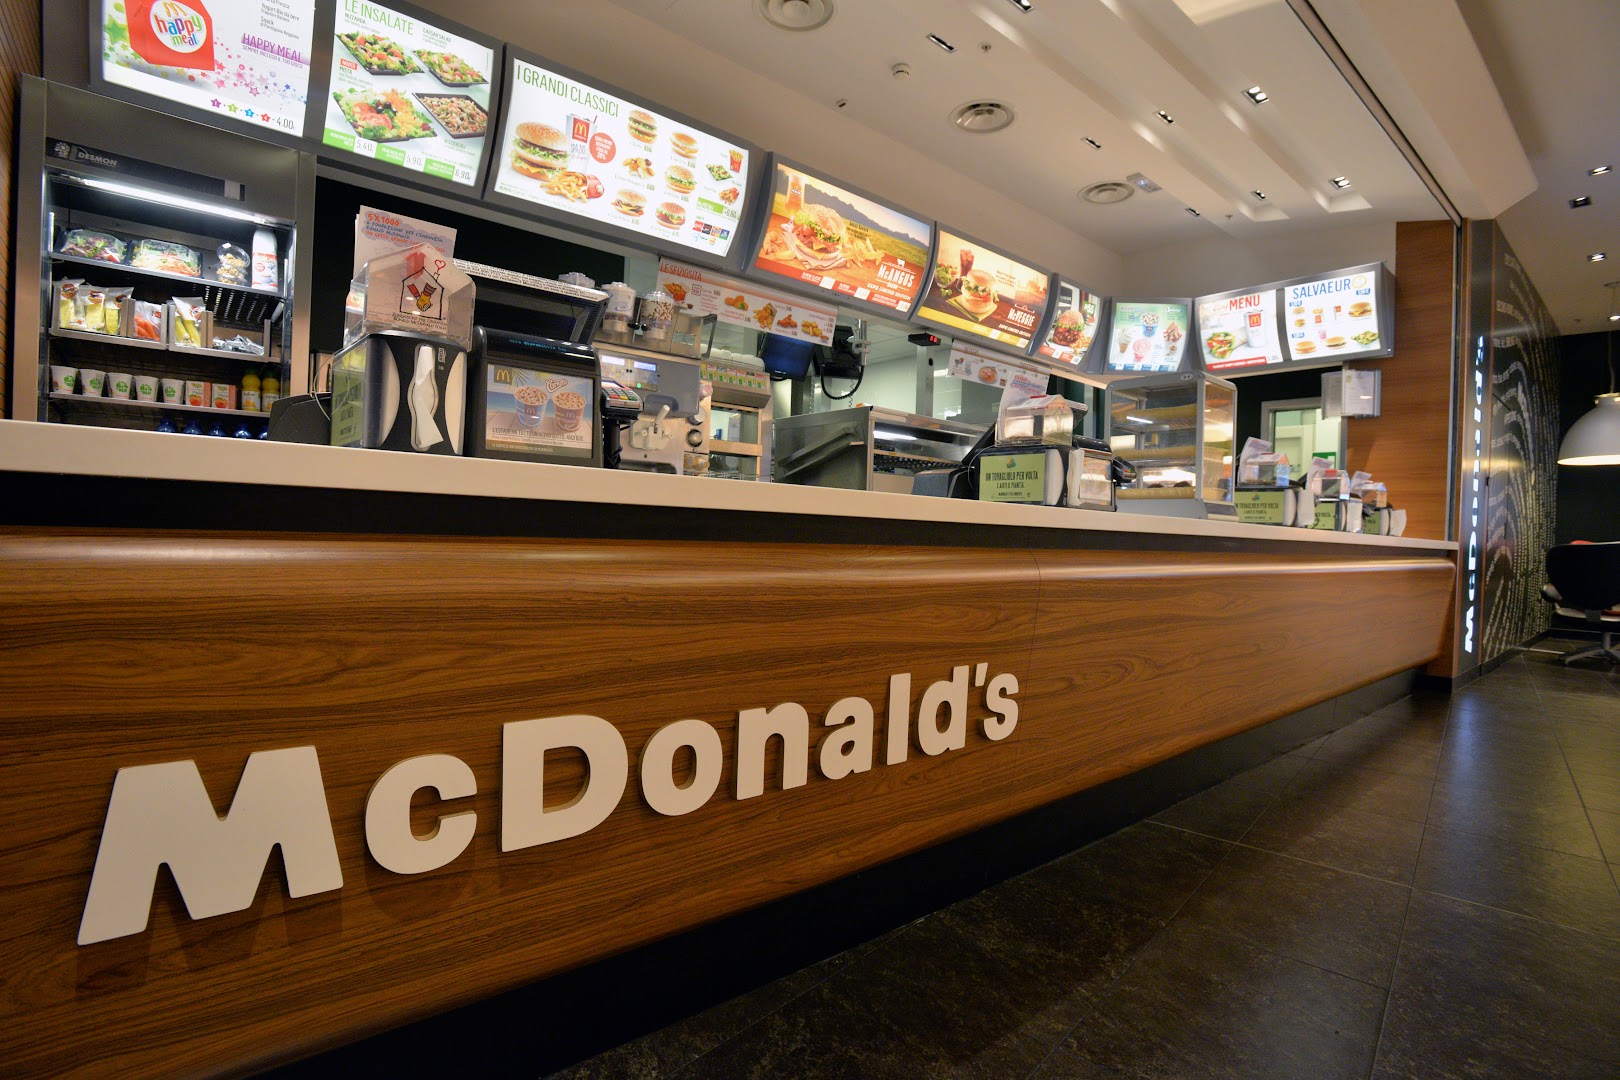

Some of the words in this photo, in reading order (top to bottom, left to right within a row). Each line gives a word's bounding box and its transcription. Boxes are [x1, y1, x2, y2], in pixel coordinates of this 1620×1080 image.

[153, 13, 203, 36] happy
[360, 3, 415, 35] INSALATE
[171, 33, 198, 46] meal
[242, 32, 276, 54] HAPPY
[276, 44, 303, 63] MEAL
[517, 64, 521, 80] I
[523, 67, 568, 98] GRANDI
[570, 86, 619, 118] CLASSICI
[78, 152, 118, 166] DESMON
[1229, 294, 1260, 311] MENU
[76, 661, 1020, 946] McDonald's
